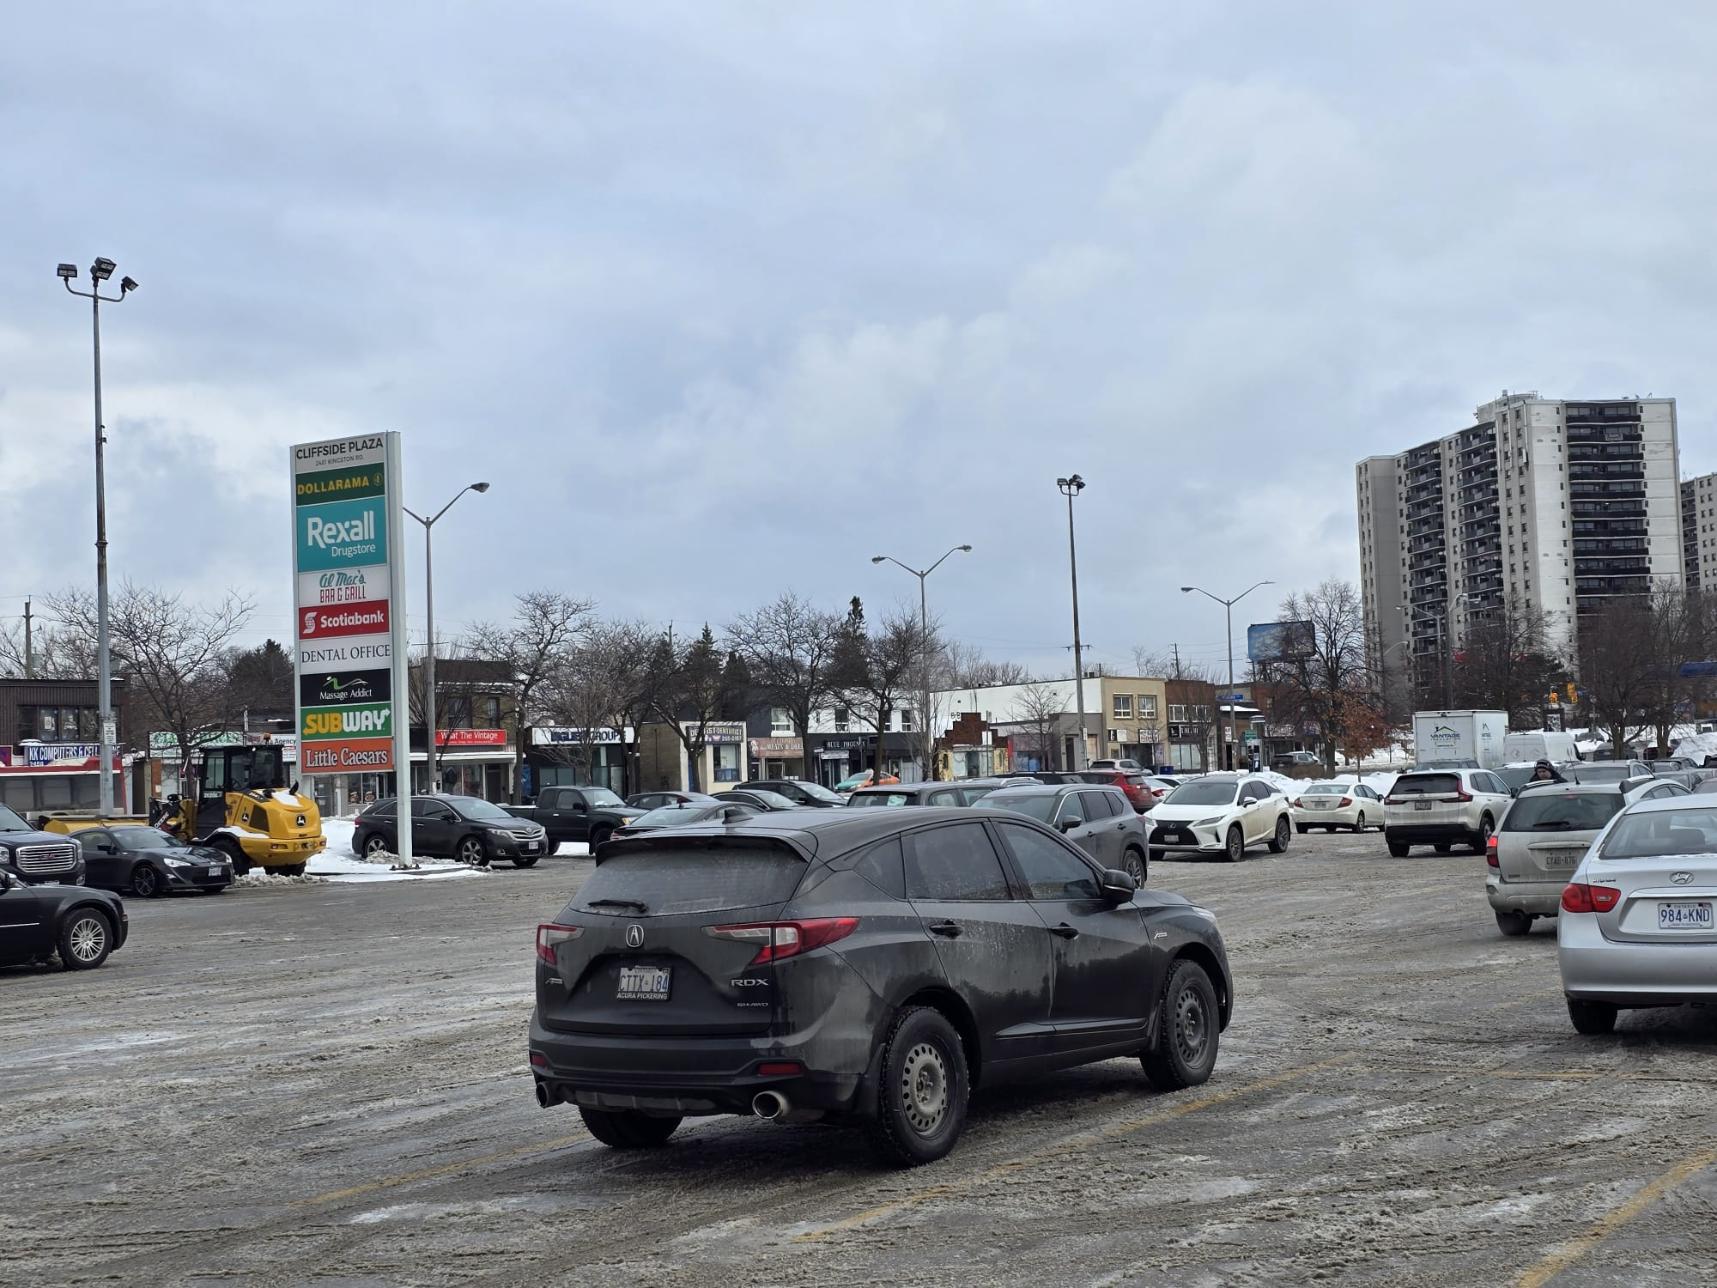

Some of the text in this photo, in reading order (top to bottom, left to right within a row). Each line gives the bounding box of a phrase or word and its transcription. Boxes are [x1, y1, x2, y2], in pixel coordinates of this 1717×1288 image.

[296, 438, 383, 460] CLIFFSIDE PLAZA
[297, 476, 369, 495] DOLLARAMA
[307, 510, 375, 549] Rexall
[331, 543, 376, 558] Drugstore
[336, 569, 367, 587] Mac's
[320, 588, 335, 603] BAR
[344, 584, 367, 601] GRILL
[320, 610, 385, 628] Scotiabank
[302, 644, 391, 664] DENTAL OFFICE
[319, 688, 372, 701] Massage Addict
[303, 708, 391, 735] SUBWAY
[460, 731, 473, 739] The
[473, 731, 498, 741] Vintage
[39, 746, 78, 761] COMPUTERS
[305, 749, 338, 768] Little
[340, 748, 388, 766] Caesars
[1660, 909, 1710, 922] 984 KND
[619, 974, 645, 993] CTTX
[731, 978, 769, 987] RDX
[636, 992, 668, 1000] PICKERING
